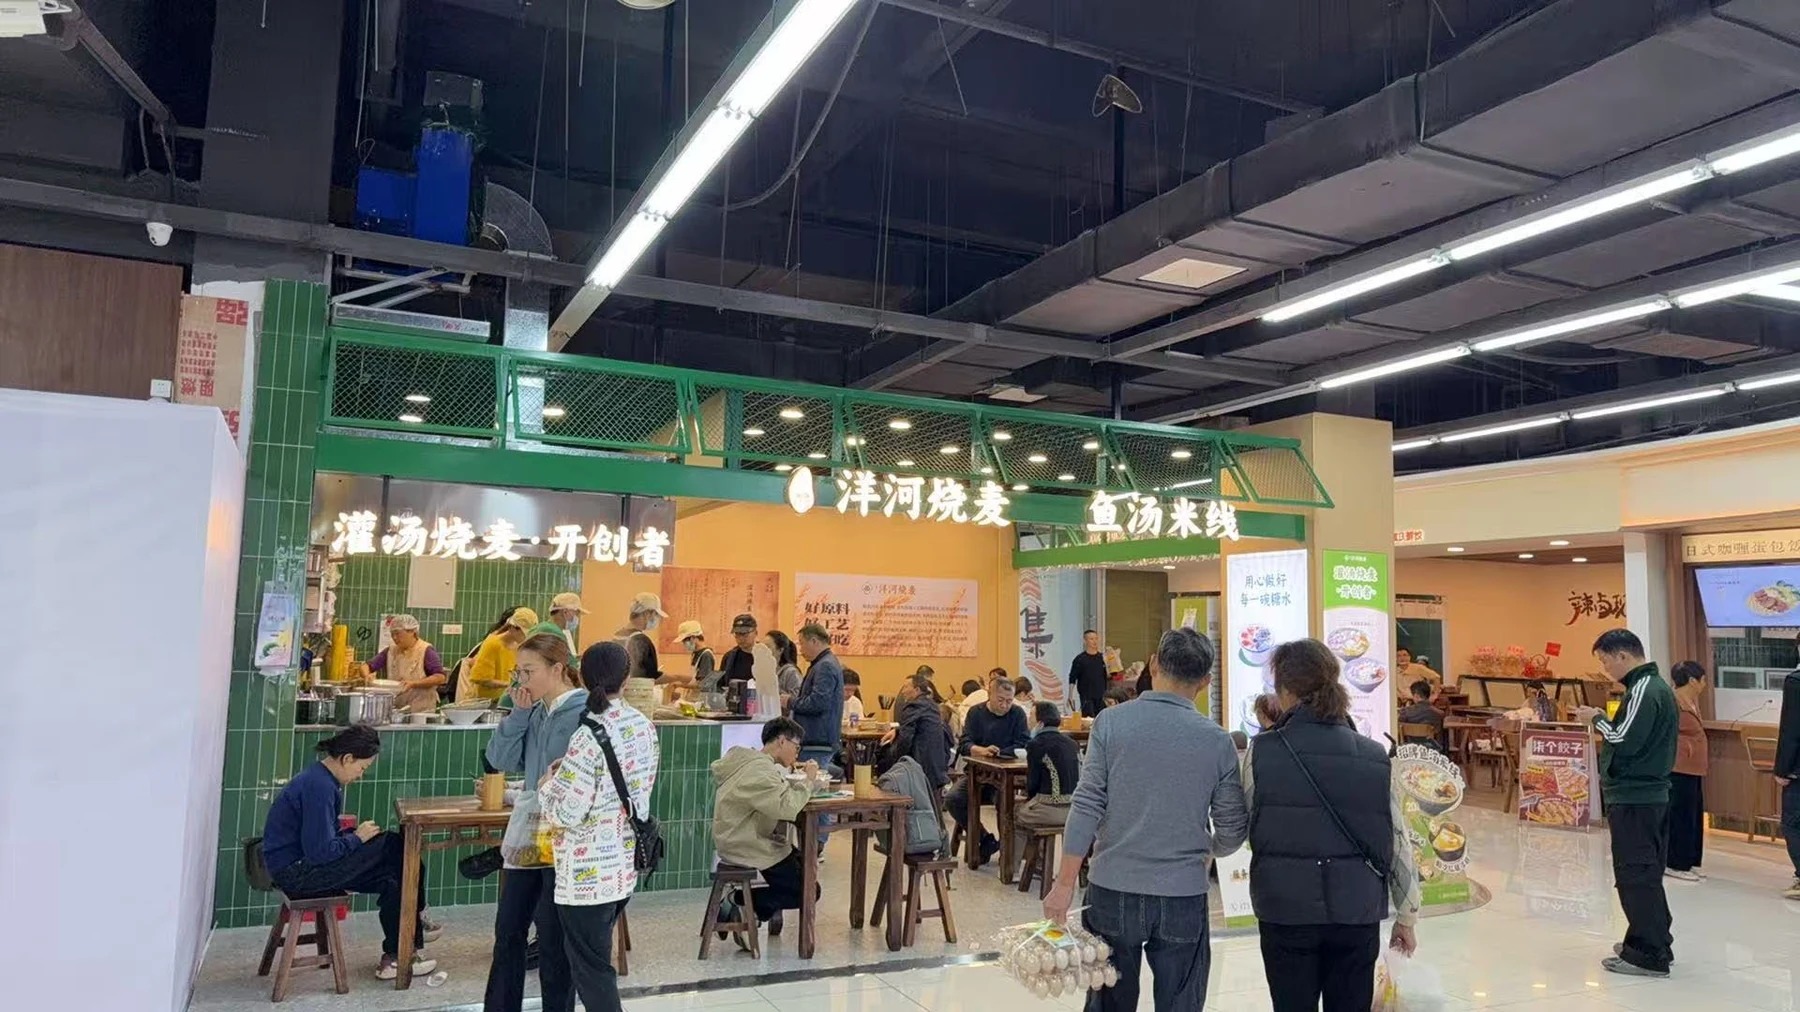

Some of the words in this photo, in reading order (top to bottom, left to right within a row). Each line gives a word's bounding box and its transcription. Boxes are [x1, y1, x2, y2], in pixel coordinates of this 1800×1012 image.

[836, 469, 1011, 528] 洋河烧麦
[1085, 490, 1240, 541] 鱼汤米线
[1245, 573, 1287, 589] 用心做好
[1240, 591, 1291, 607] 每一碗糖水
[805, 602, 849, 615] 好原料
